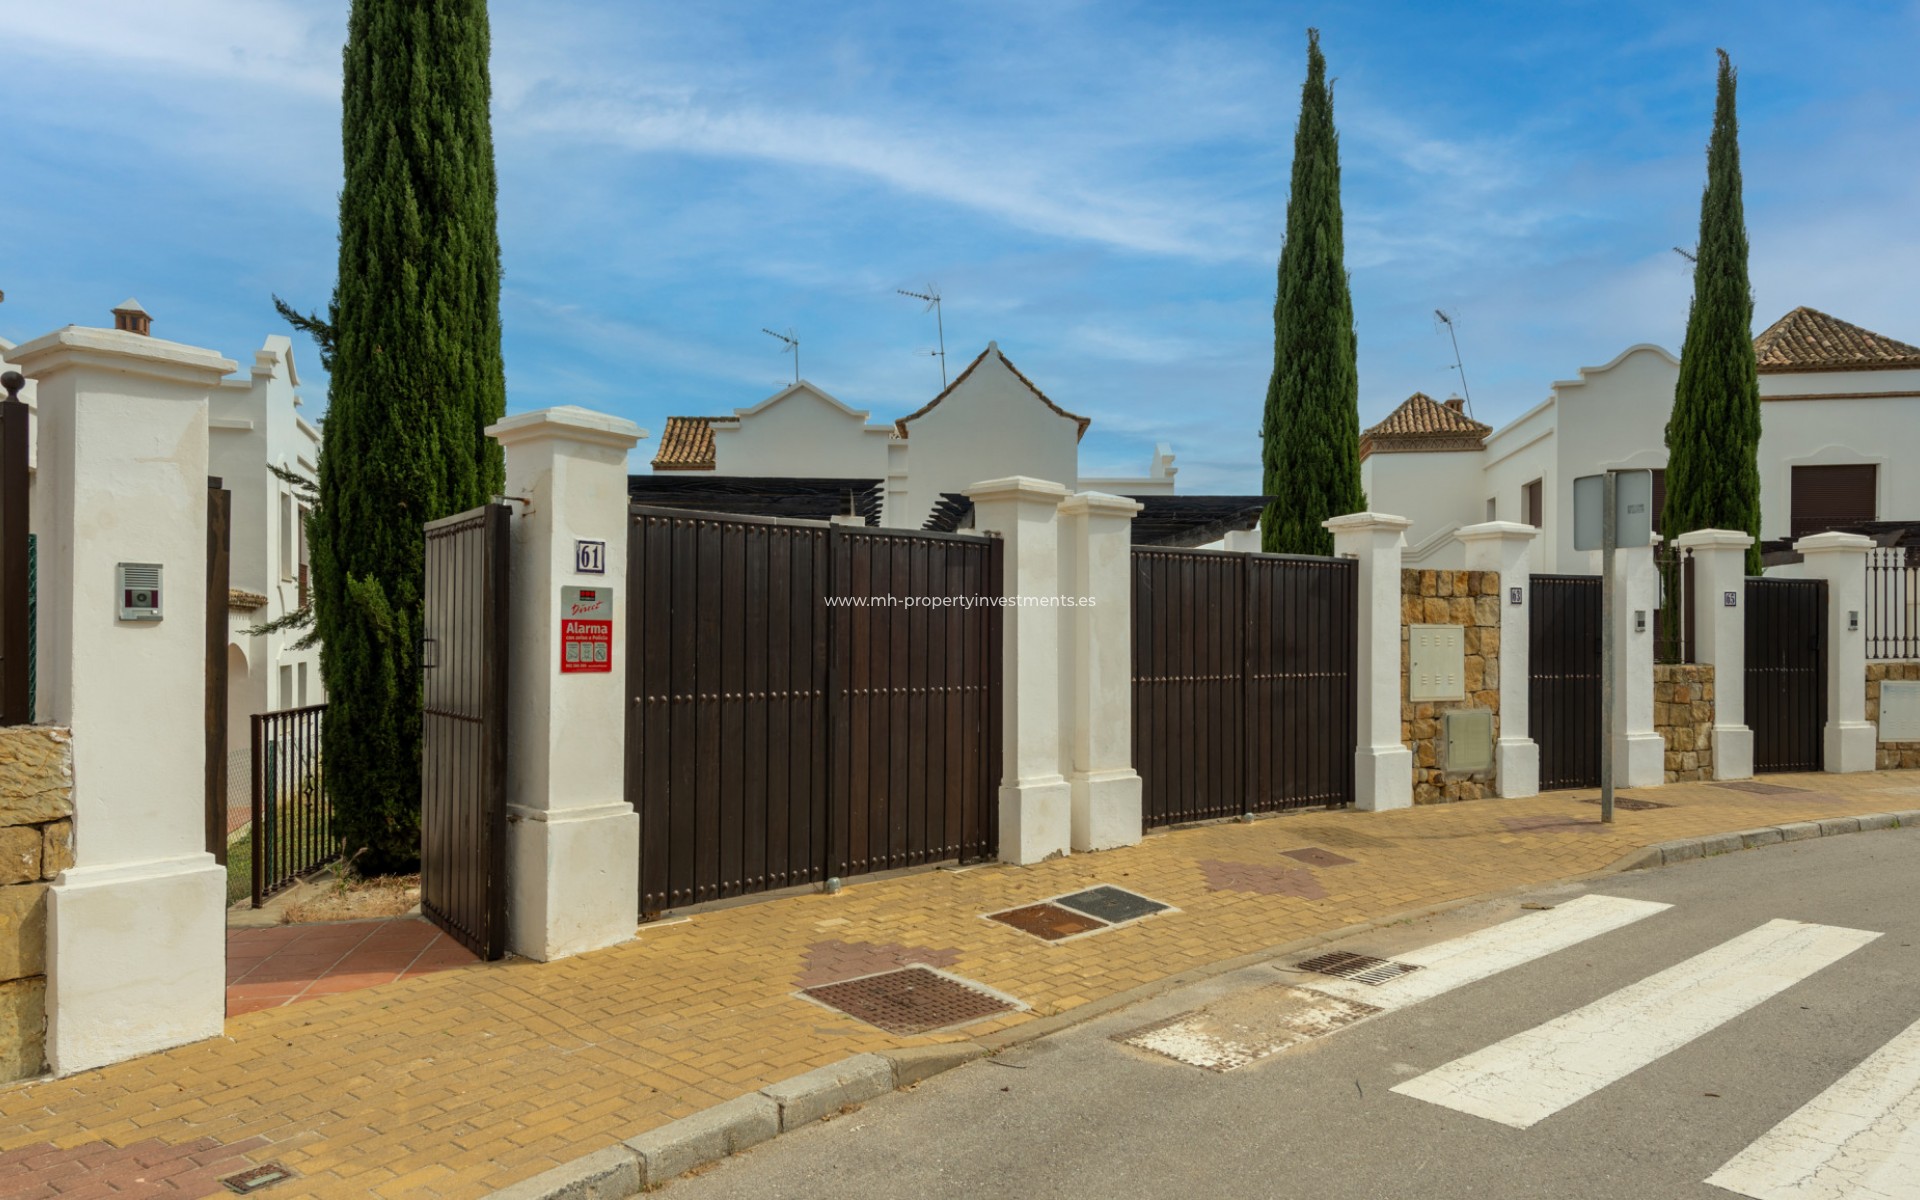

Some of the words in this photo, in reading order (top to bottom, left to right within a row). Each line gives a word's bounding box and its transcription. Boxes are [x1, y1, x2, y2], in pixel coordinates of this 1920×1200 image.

[581, 545, 599, 568] 61
[571, 600, 604, 616] Direct
[566, 622, 608, 634] Alarma
